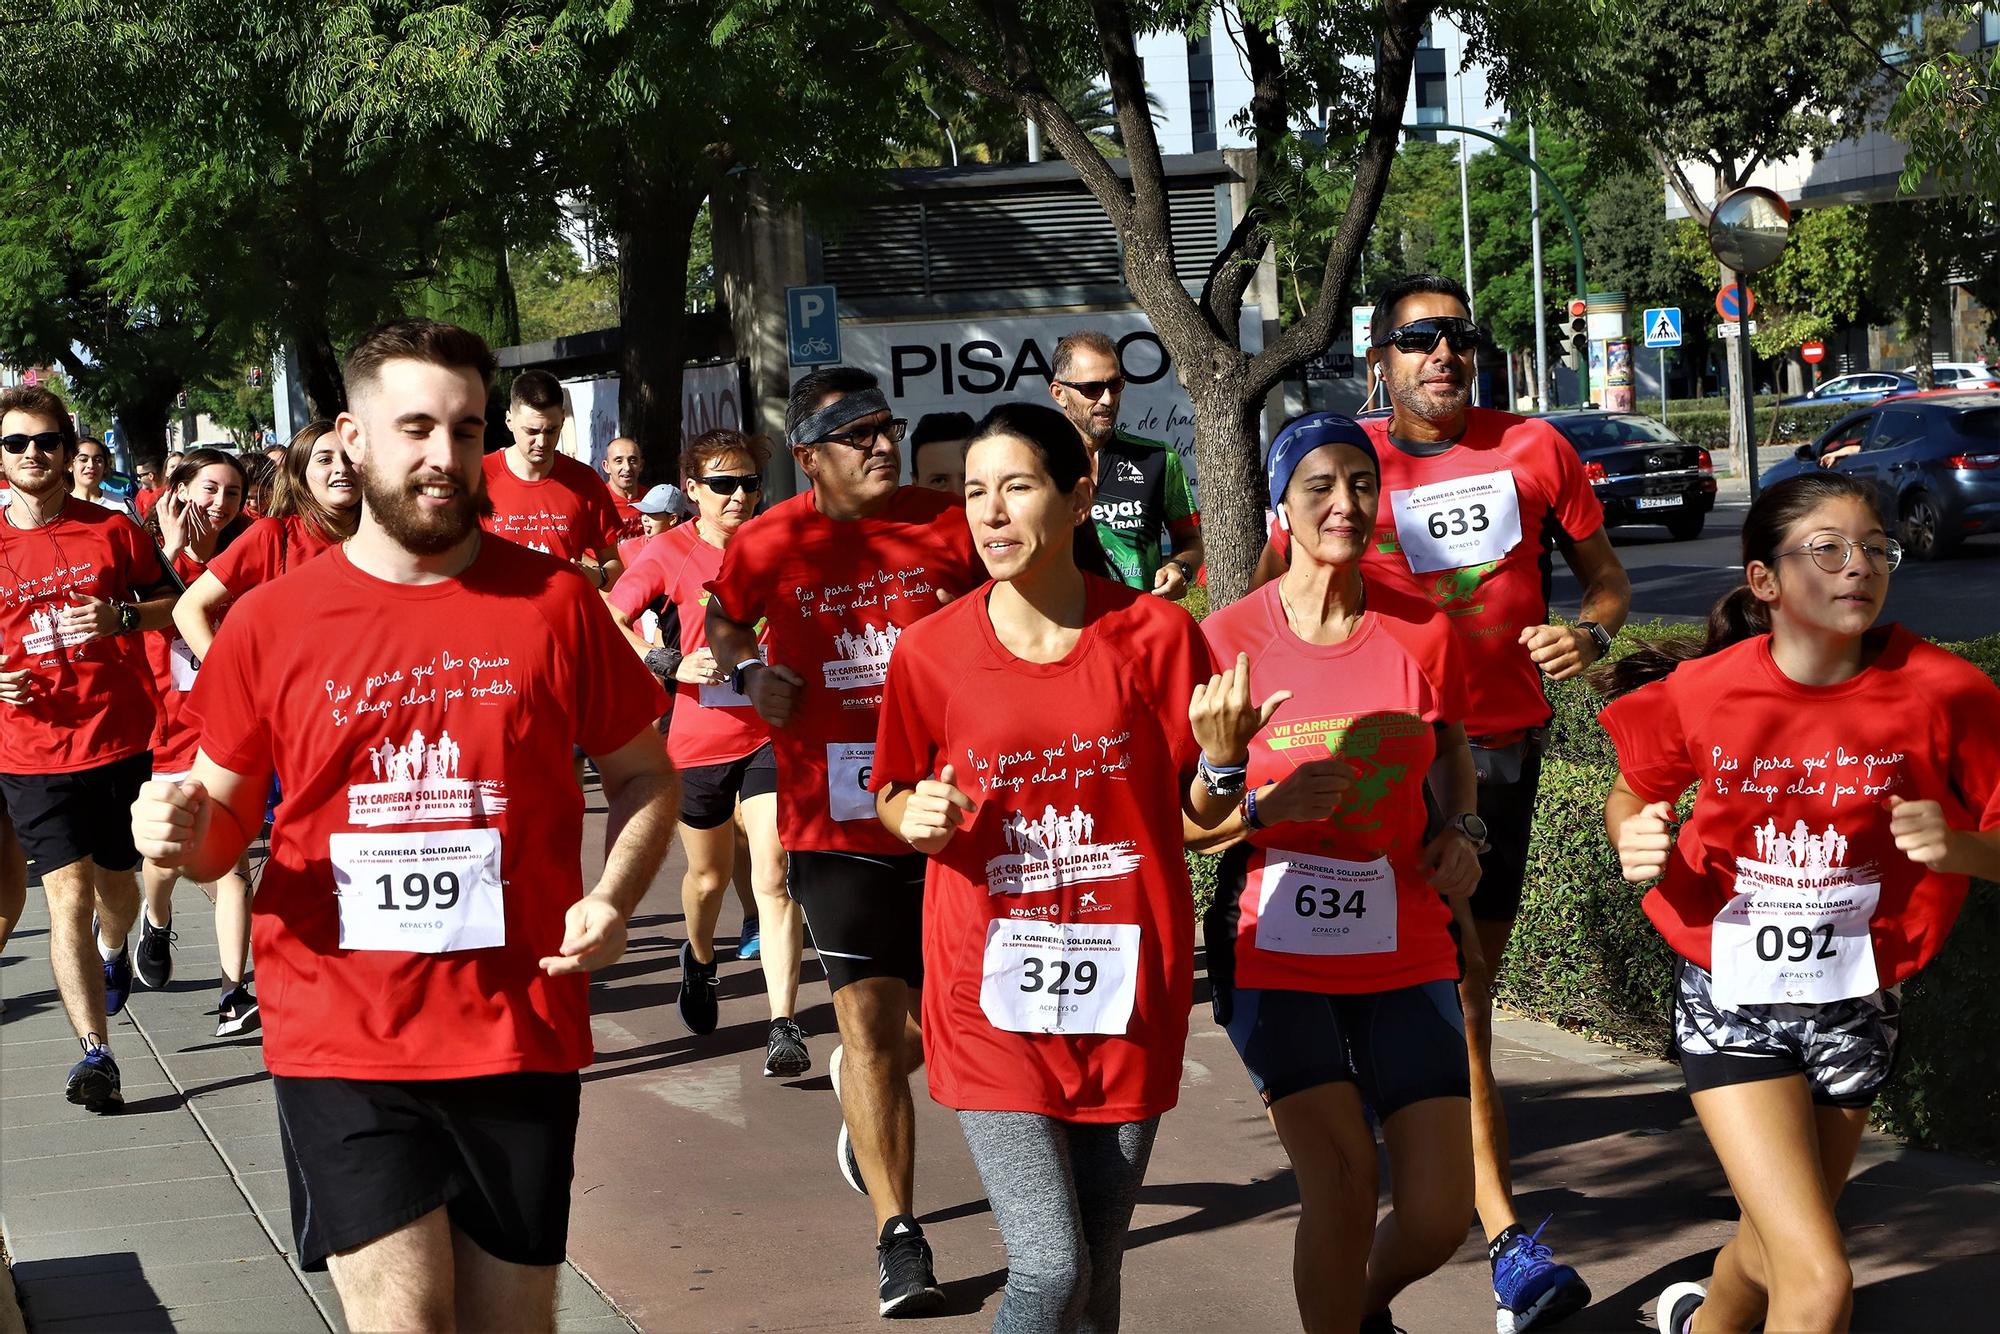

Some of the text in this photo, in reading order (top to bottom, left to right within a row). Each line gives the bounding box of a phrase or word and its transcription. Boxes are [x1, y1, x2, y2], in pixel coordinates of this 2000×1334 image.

[800, 295, 824, 328] P
[891, 331, 1172, 398] PISAO
[1138, 407, 1159, 430] de
[1422, 491, 1454, 502] CARRERA
[1456, 484, 1493, 495] SOLIDARIA
[1110, 520, 1145, 530] TRAIL
[1428, 503, 1490, 539] 633
[795, 586, 815, 603] Pies
[824, 584, 853, 602] para
[858, 576, 875, 595] qué
[878, 569, 894, 584] los
[801, 605, 812, 618] Si
[819, 601, 846, 616] tengo
[851, 594, 878, 609] alas
[325, 650, 510, 703] Pies para qué los quiero
[828, 664, 874, 676] IX CARRERA
[332, 708, 348, 727] Si
[356, 699, 392, 719] tengo
[400, 688, 436, 706] alas
[842, 697, 874, 706] ACPACYS
[1274, 725, 1290, 738] VII
[1294, 717, 1354, 734] CARRERA
[1290, 733, 1327, 747] COVID
[967, 749, 988, 772] Pies
[999, 751, 1036, 774] para
[1043, 740, 1066, 766] qué
[1072, 733, 1093, 752] los
[1712, 746, 1905, 778] Pies para qué los quiero
[991, 774, 1025, 792] tengo
[1031, 767, 1067, 784] alas
[1715, 777, 1729, 795] Si
[1741, 778, 1779, 803] tengo
[1787, 777, 1827, 795] alas
[357, 789, 475, 806] IX CARRERA SOLIDARIA
[387, 804, 411, 813] ANDA
[424, 802, 456, 810] RUEDA
[420, 846, 471, 856] SOLIDARIA
[993, 852, 1110, 876] IX CARRERA SOLIDARIA
[1024, 872, 1049, 882] ANDA
[1059, 865, 1088, 876] RUEDA
[1092, 863, 1113, 871] 2022
[1299, 863, 1334, 875] CARRERA
[1336, 869, 1378, 877] SOLIDARIA
[1743, 868, 1854, 889] IX CARRERA SOLIDARIA
[376, 871, 460, 911] 199
[1295, 885, 1366, 919] 634
[1010, 906, 1048, 917] ACPACYS
[1757, 901, 1803, 909] CARRERA
[1805, 899, 1853, 909] SOLIDARIA
[1024, 935, 1065, 945] CARRERA
[1311, 926, 1341, 934] ACPACYS
[1756, 923, 1837, 962] 092
[1020, 957, 1098, 996] 329
[1779, 971, 1814, 979] ACPACYS
